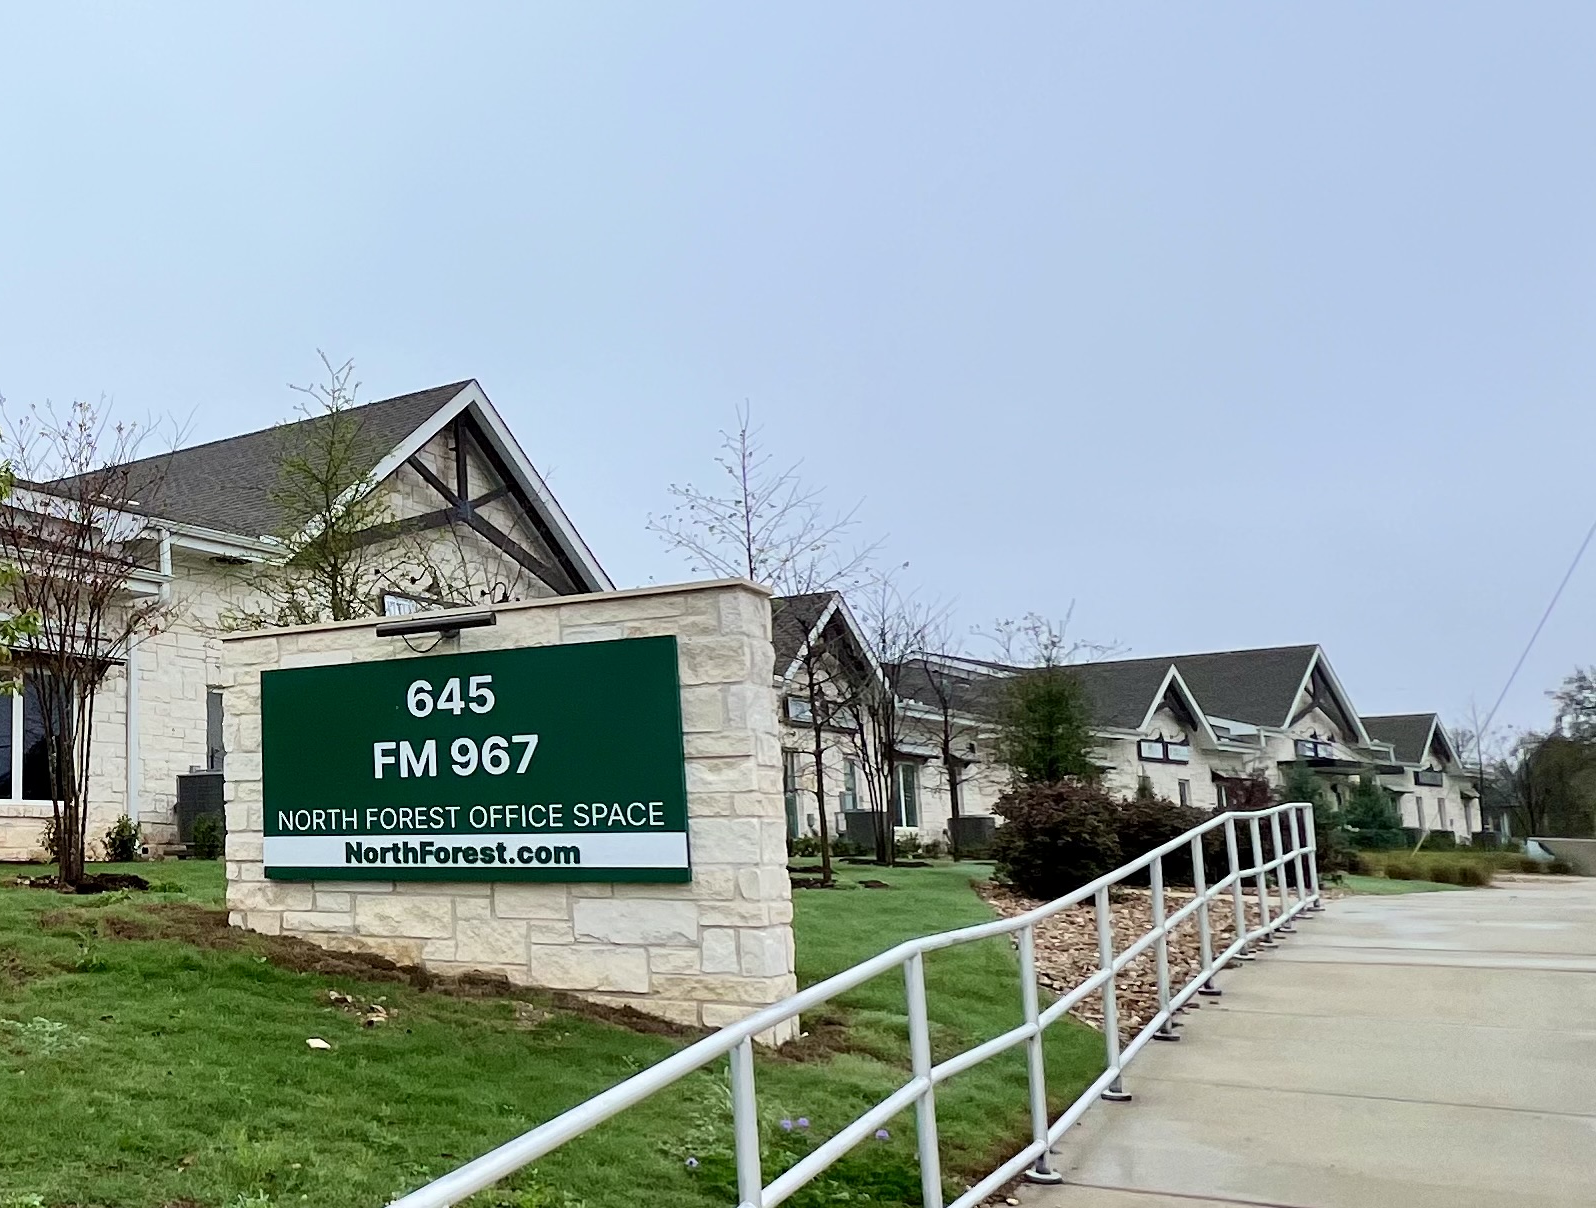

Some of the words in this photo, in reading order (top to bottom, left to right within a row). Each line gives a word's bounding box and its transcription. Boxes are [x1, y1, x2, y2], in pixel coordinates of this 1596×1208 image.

[406, 674, 496, 718] 645
[373, 739, 438, 779] FM
[450, 734, 539, 777] 967
[278, 808, 358, 831] NORTH
[366, 806, 461, 830] FOREST
[469, 803, 564, 829] OFFICE
[573, 801, 665, 827] SPACE
[344, 840, 581, 865] NorthForest.com
